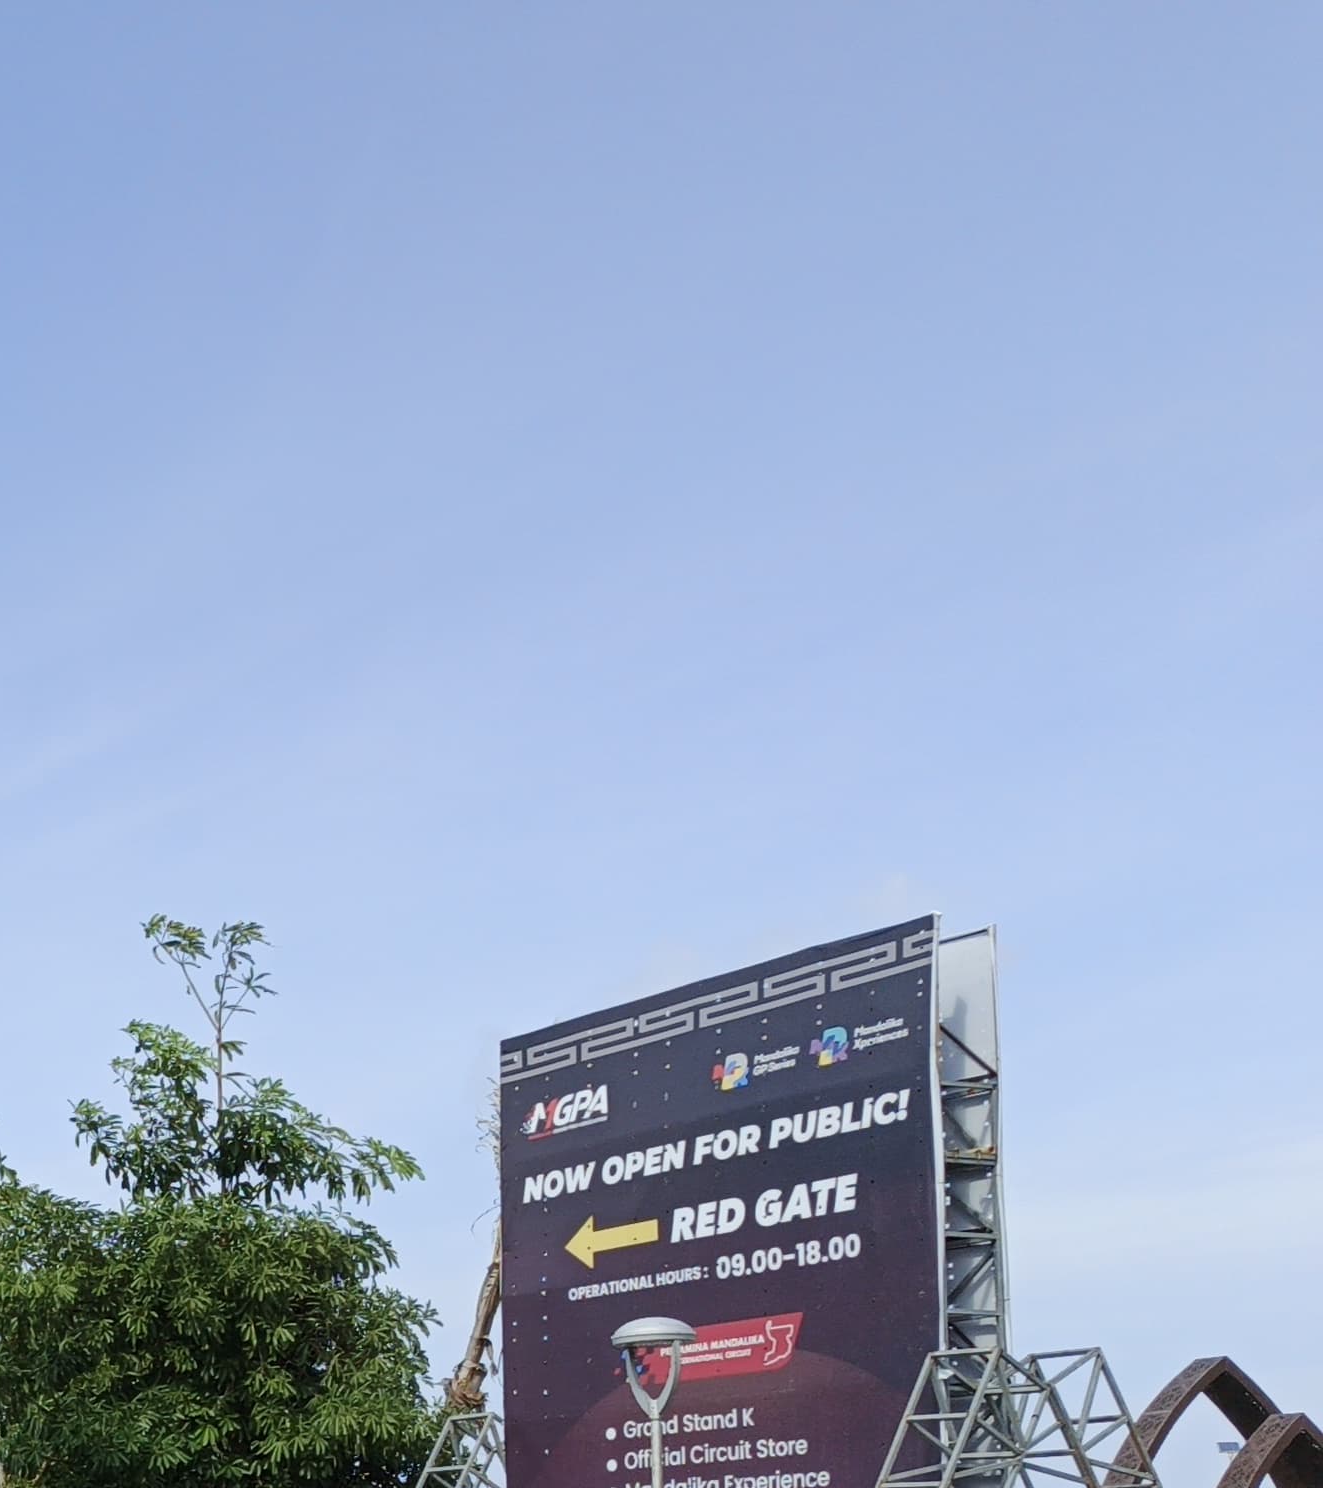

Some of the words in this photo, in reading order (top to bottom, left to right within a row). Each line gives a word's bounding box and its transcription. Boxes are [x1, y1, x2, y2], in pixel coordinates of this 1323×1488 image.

[753, 1063, 768, 1076] GP
[769, 1058, 796, 1074] Series
[523, 1084, 608, 1134] MGPA
[522, 1161, 595, 1203] NOW
[601, 1139, 686, 1185] OPEN
[693, 1125, 761, 1165] FOR
[769, 1089, 911, 1149] PUBLIC!
[670, 1197, 746, 1243] RED
[755, 1173, 858, 1227] GATE
[568, 1277, 654, 1301] OPERATIONAL
[716, 1233, 861, 1279] 09.00-18.00
[710, 1334, 765, 1350] MANDALIKA
[682, 1408, 737, 1433] Stand
[742, 1408, 755, 1427] K
[624, 1446, 686, 1470] Offial
[690, 1440, 752, 1464] Circuit
[756, 1438, 808, 1459] Store
